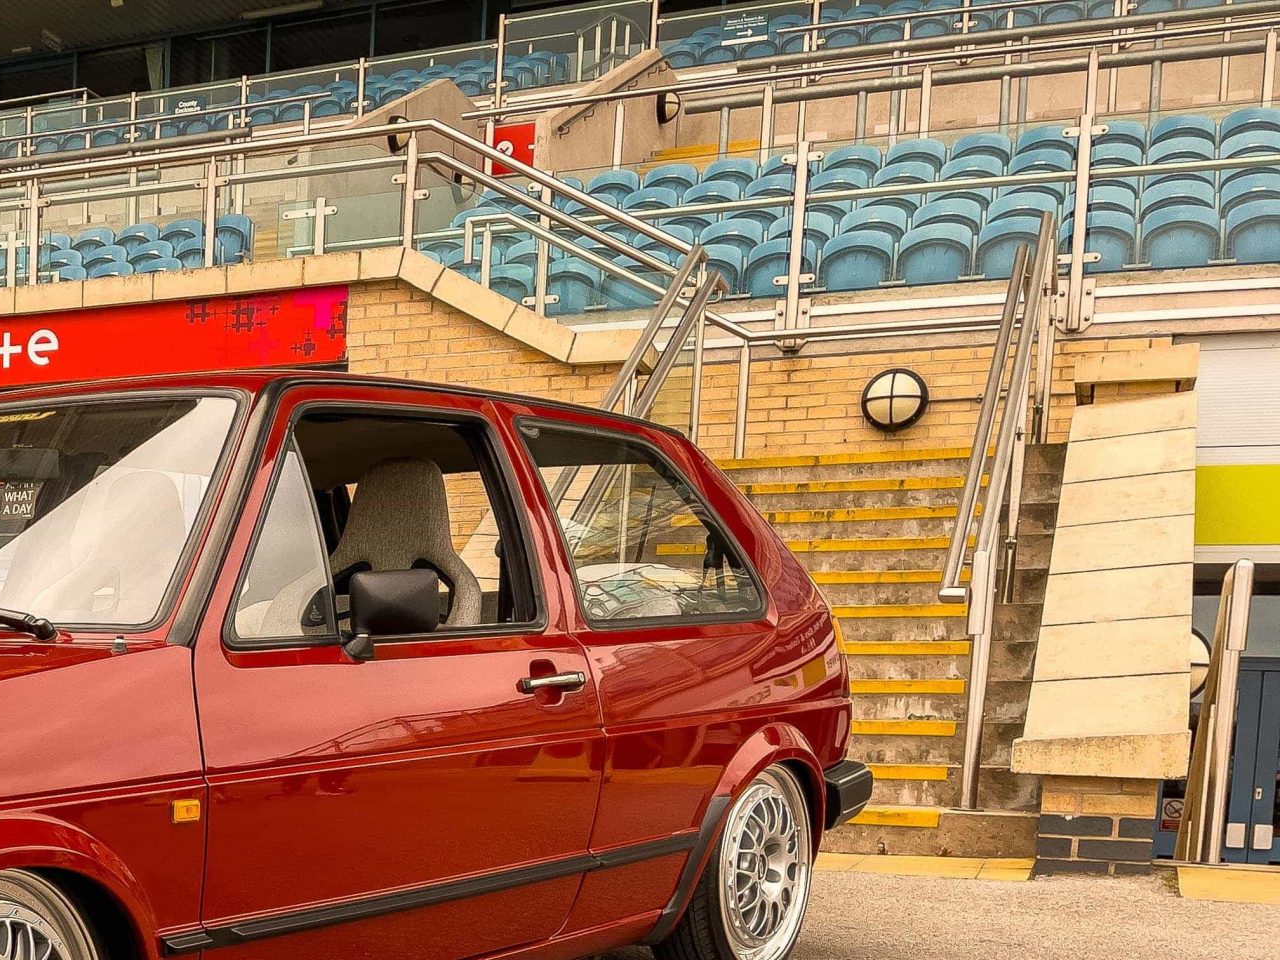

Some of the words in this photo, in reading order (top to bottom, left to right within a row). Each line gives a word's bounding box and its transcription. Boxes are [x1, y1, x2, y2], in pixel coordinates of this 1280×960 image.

[4, 490, 34, 503] WHAT
[2, 504, 11, 515] A
[12, 503, 33, 515] DAY
